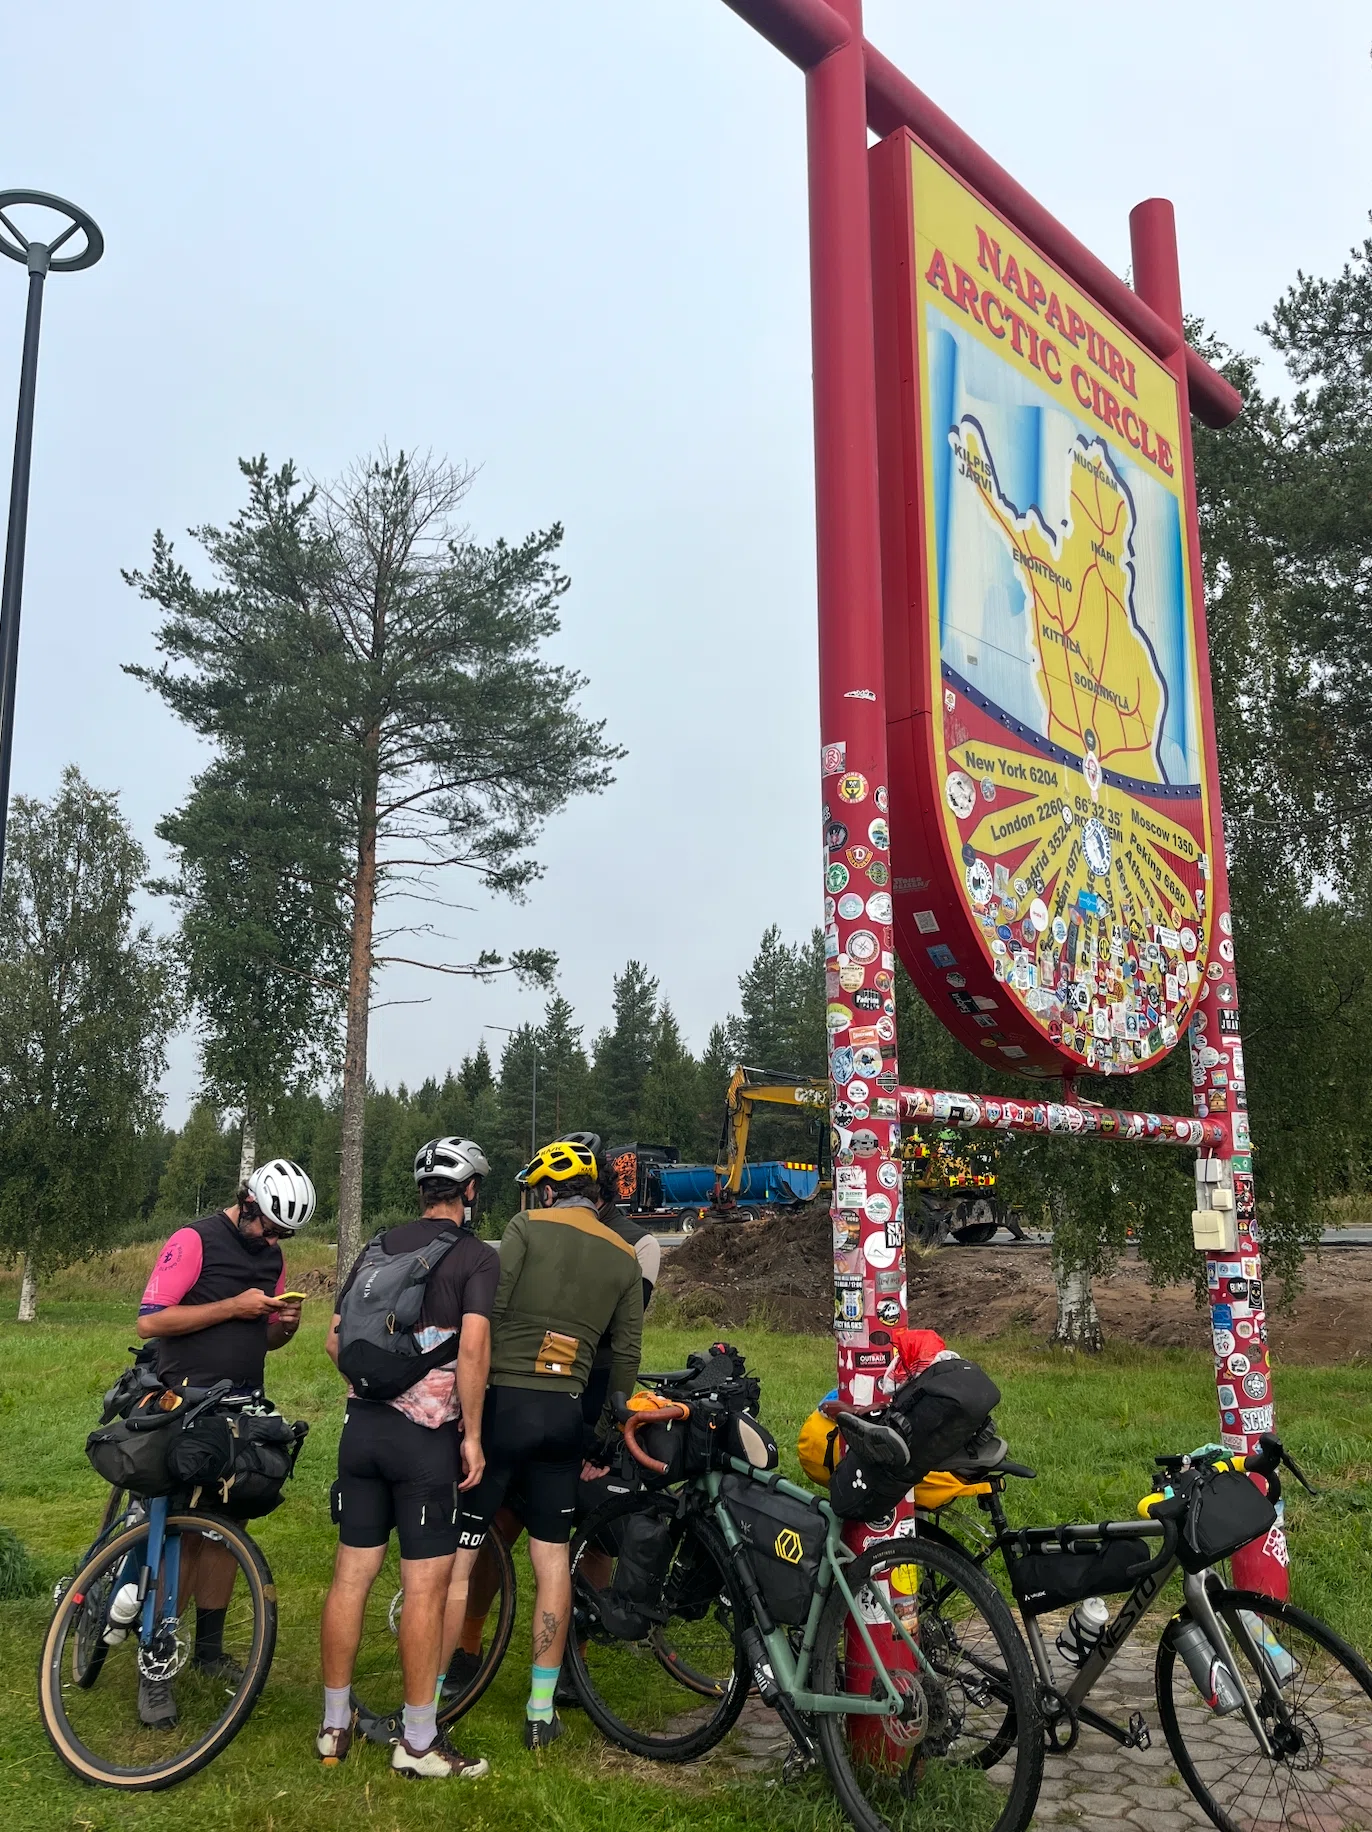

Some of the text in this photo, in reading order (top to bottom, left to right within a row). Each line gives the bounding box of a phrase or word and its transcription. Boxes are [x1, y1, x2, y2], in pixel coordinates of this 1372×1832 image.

[975, 224, 1138, 399] NAPAPIIRI
[925, 248, 1174, 478] ARCTIC CIRCLE
[954, 443, 992, 476] KILPIS
[1013, 548, 1072, 592] ENONTEKIÖ
[1091, 540, 1115, 566] INARI
[1042, 624, 1081, 655] KITTILÄ
[1074, 672, 1130, 711] SODANKYLÄ
[965, 751, 1059, 787] New York 6204
[991, 798, 1063, 841] London 2260
[1131, 808, 1194, 857] Moscow 1350
[1115, 857, 1136, 917] Berlin
[1124, 850, 1155, 908] Athens
[1130, 832, 1161, 881] Peking
[1164, 875, 1186, 908] 6680
[1081, 914, 1093, 967] Paris
[1095, 1573, 1157, 1661] NESTO
